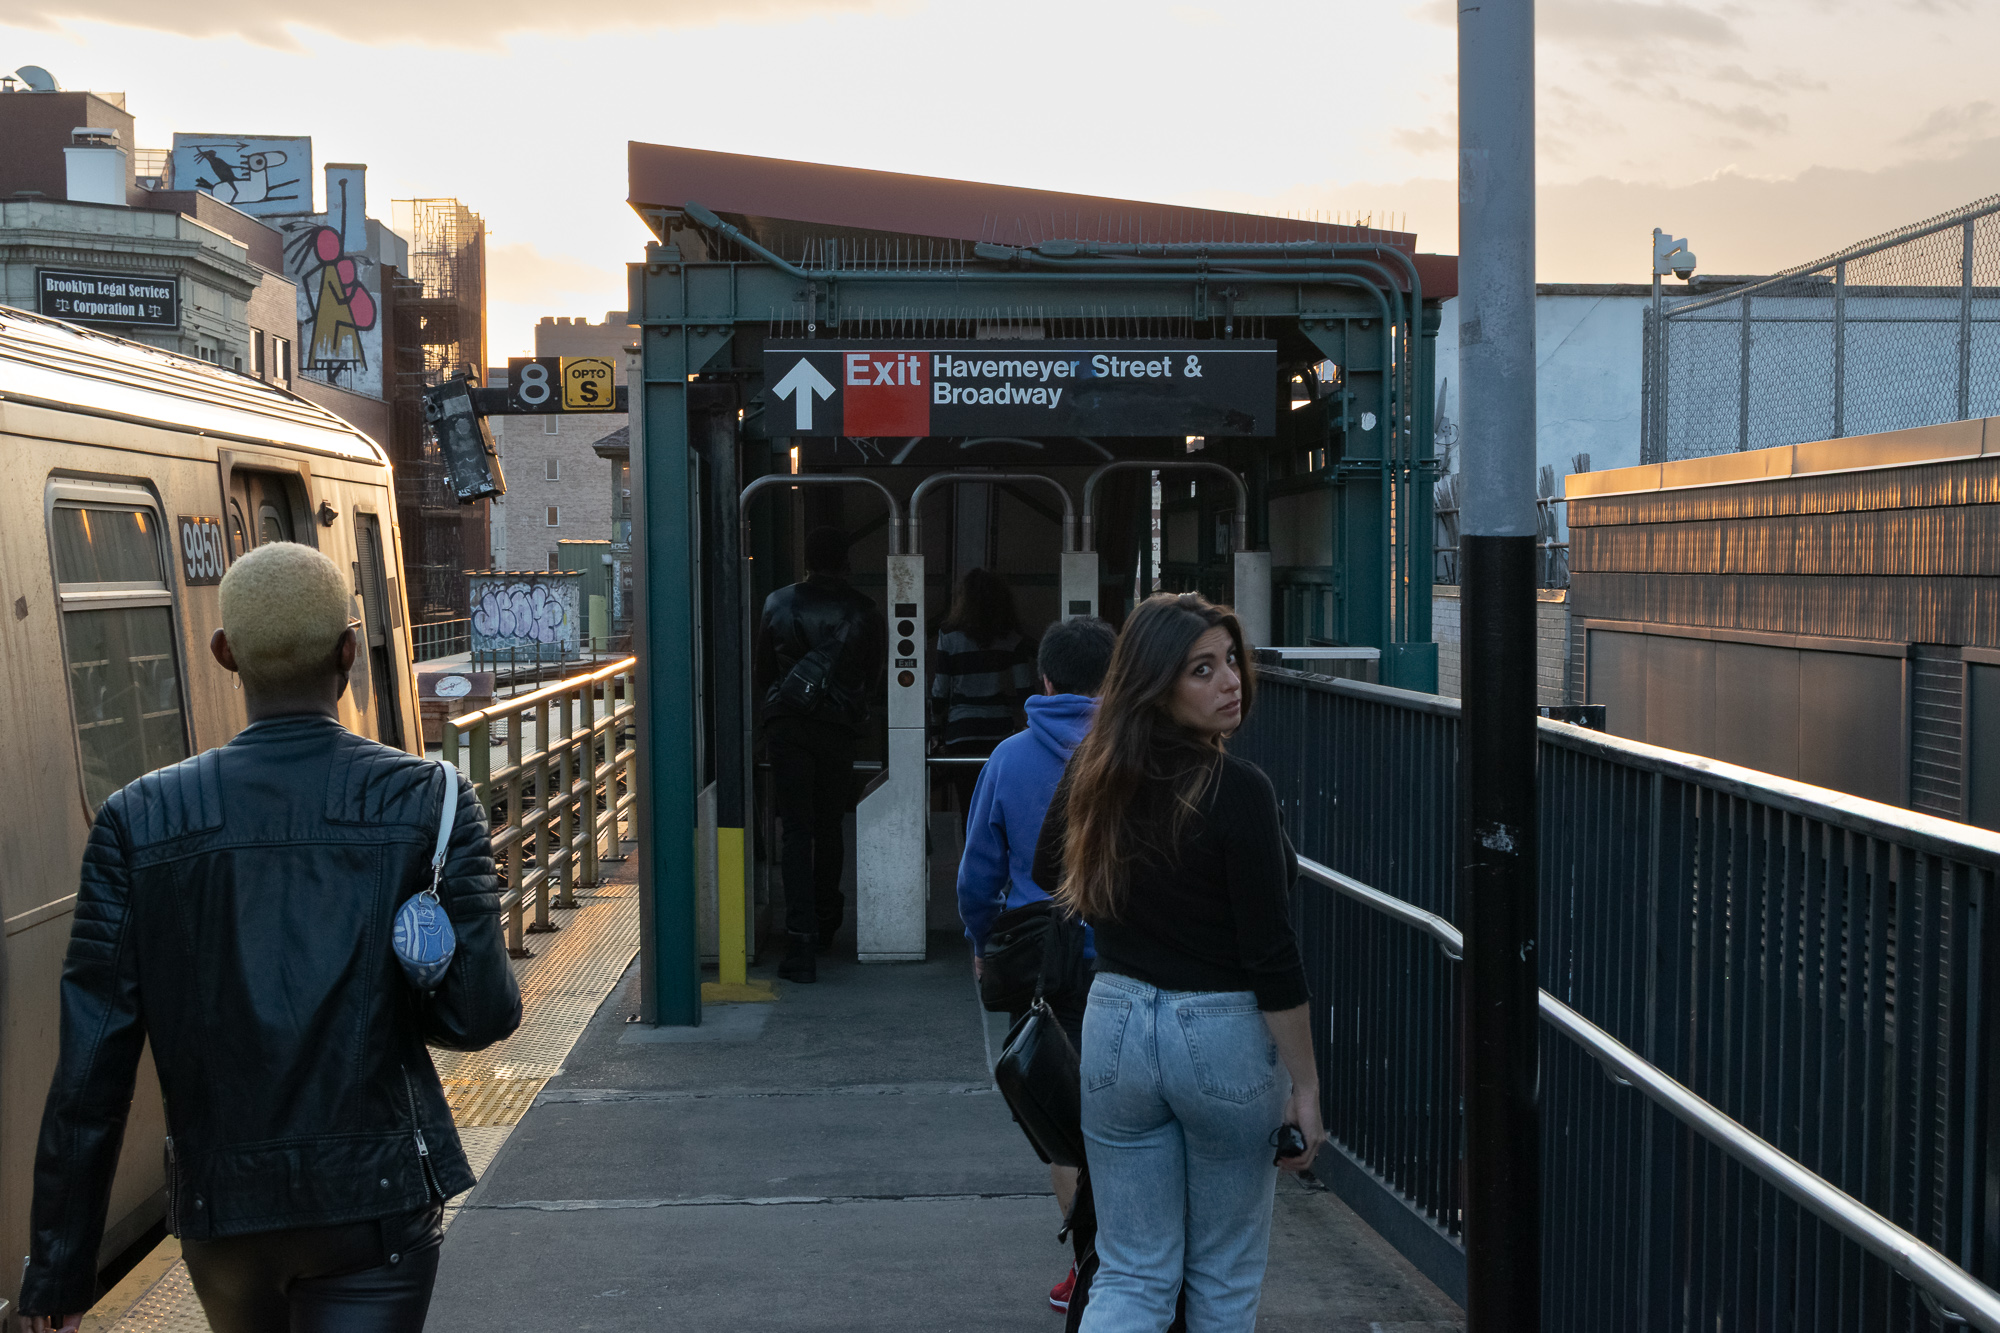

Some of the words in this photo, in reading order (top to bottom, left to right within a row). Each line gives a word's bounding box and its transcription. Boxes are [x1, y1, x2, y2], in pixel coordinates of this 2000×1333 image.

[46, 278, 95, 294] Brooklyn
[97, 282, 126, 297] Legal
[128, 284, 170, 299] Services
[73, 300, 135, 316] Corporation
[137, 304, 145, 317] A
[571, 369, 606, 379] OPTO
[846, 353, 921, 386] Exit
[933, 354, 1080, 382] Havemeyer
[1091, 354, 1172, 378] Street
[1183, 354, 1203, 378] &
[520, 363, 551, 405] 8
[580, 380, 599, 403] S
[933, 381, 1063, 409] Broadway
[183, 522, 224, 578] 9950
[898, 659, 914, 667] Exit
